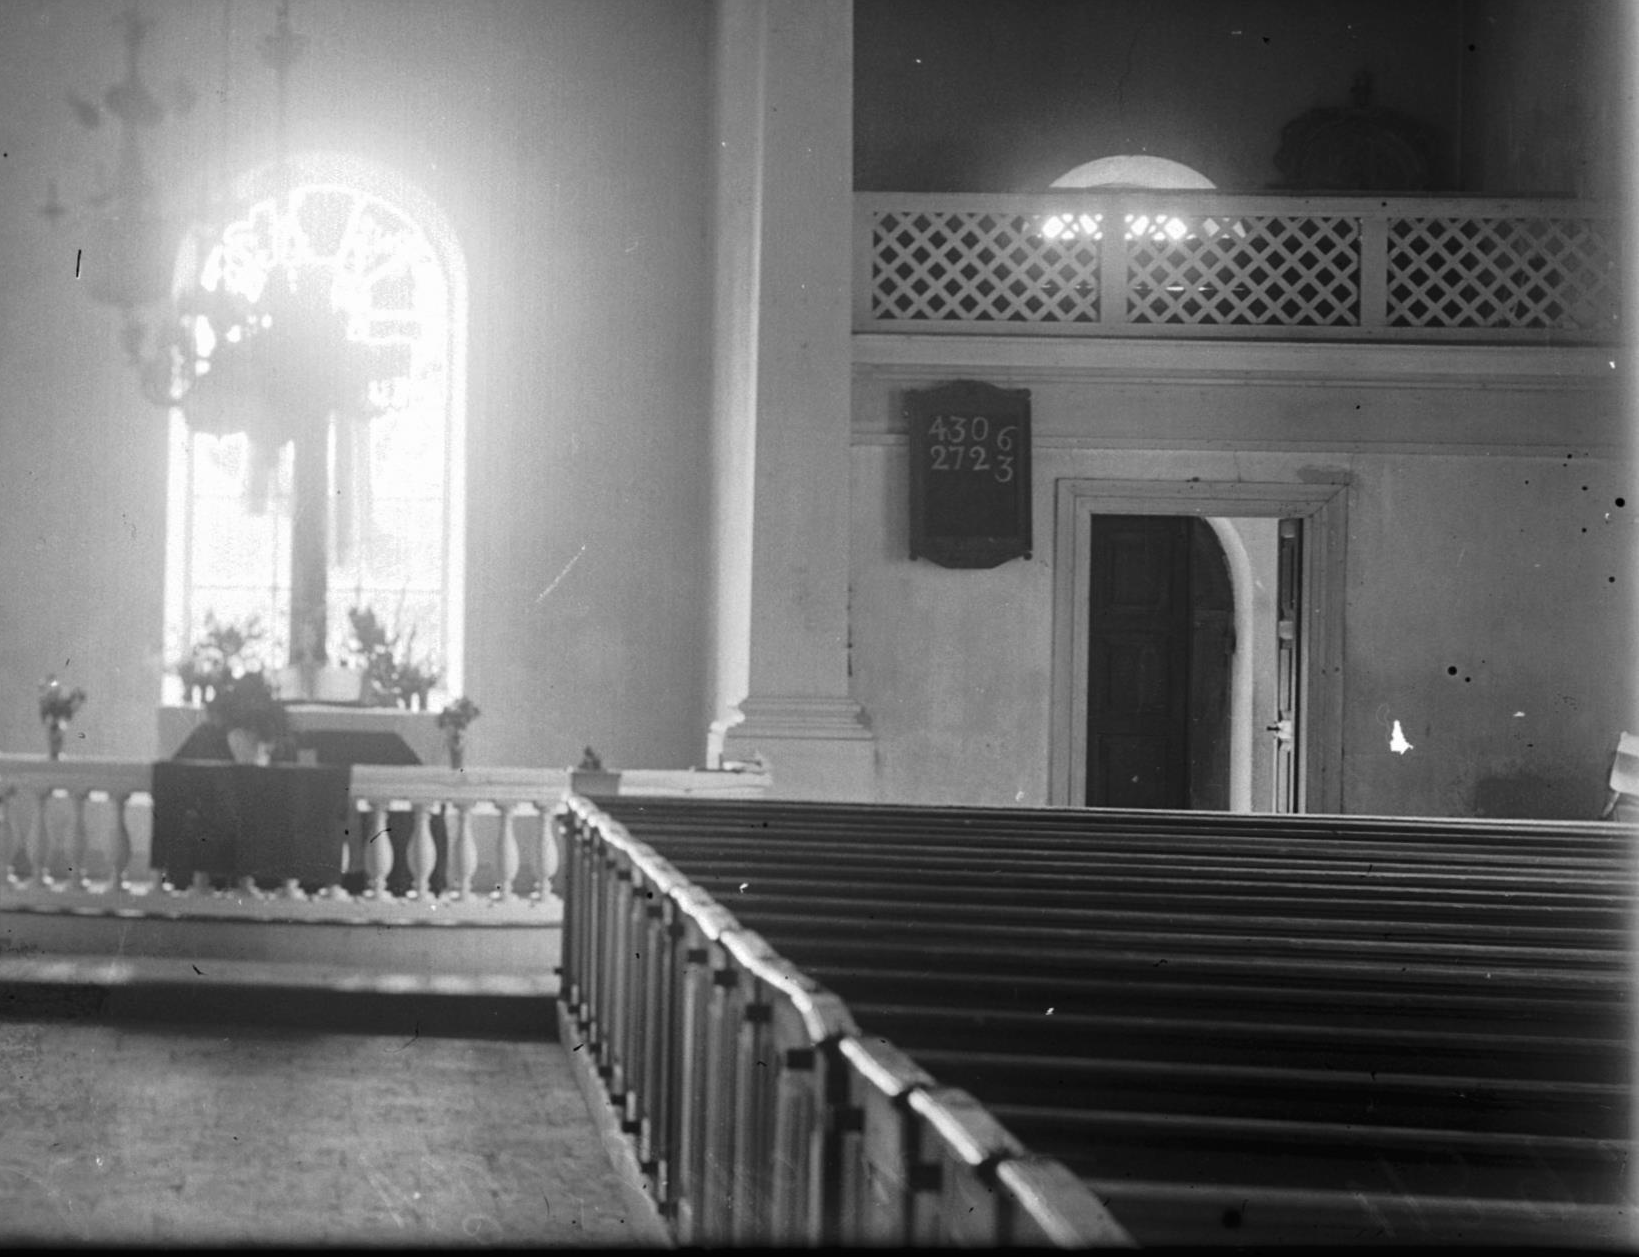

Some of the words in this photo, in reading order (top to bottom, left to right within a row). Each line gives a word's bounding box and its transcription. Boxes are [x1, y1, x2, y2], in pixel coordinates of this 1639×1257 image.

[928, 414, 989, 443] 430
[996, 425, 1018, 452] 6
[930, 445, 991, 471] 272
[994, 455, 1014, 483] 3
